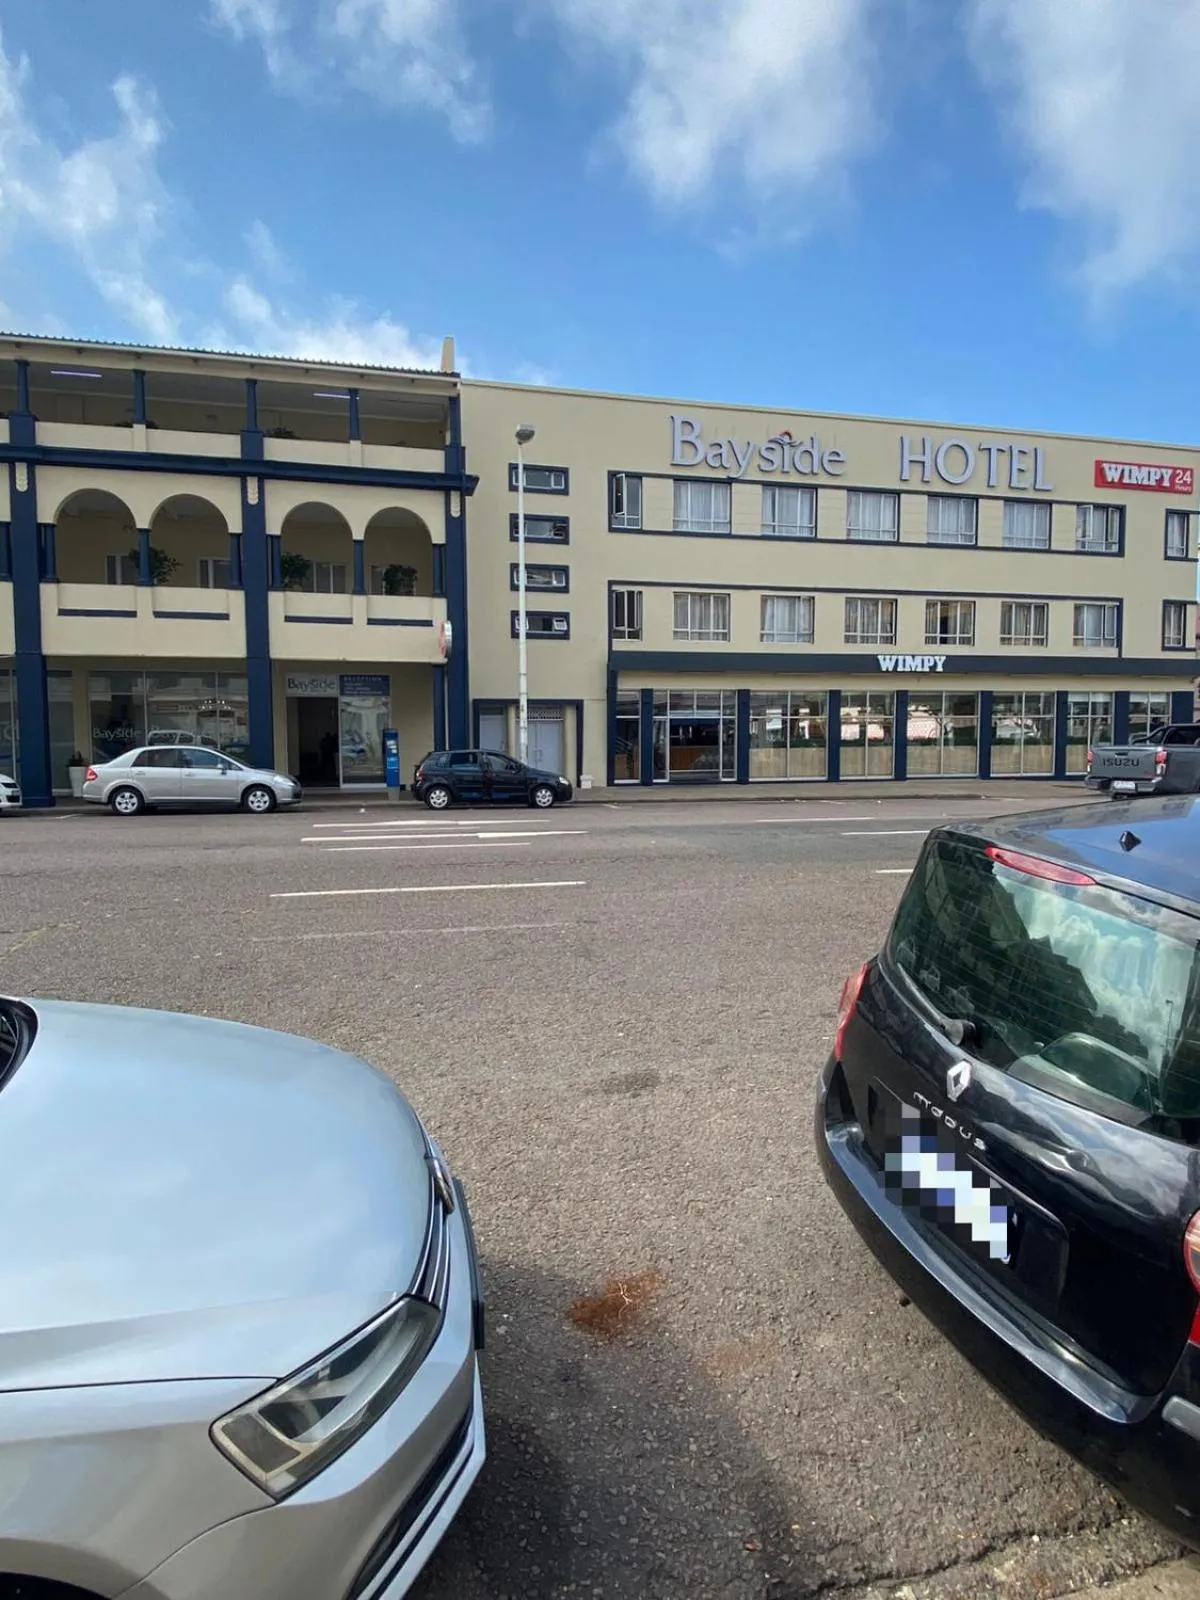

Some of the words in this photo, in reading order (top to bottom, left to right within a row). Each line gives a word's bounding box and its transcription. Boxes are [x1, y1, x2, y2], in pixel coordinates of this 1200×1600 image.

[670, 415, 847, 480] Bayside
[900, 434, 1053, 492] HOTEL
[1103, 463, 1173, 488] WIMPY
[1175, 469, 1192, 485] 24
[877, 654, 947, 672] WIMPY
[1103, 758, 1140, 768] ISUZU
